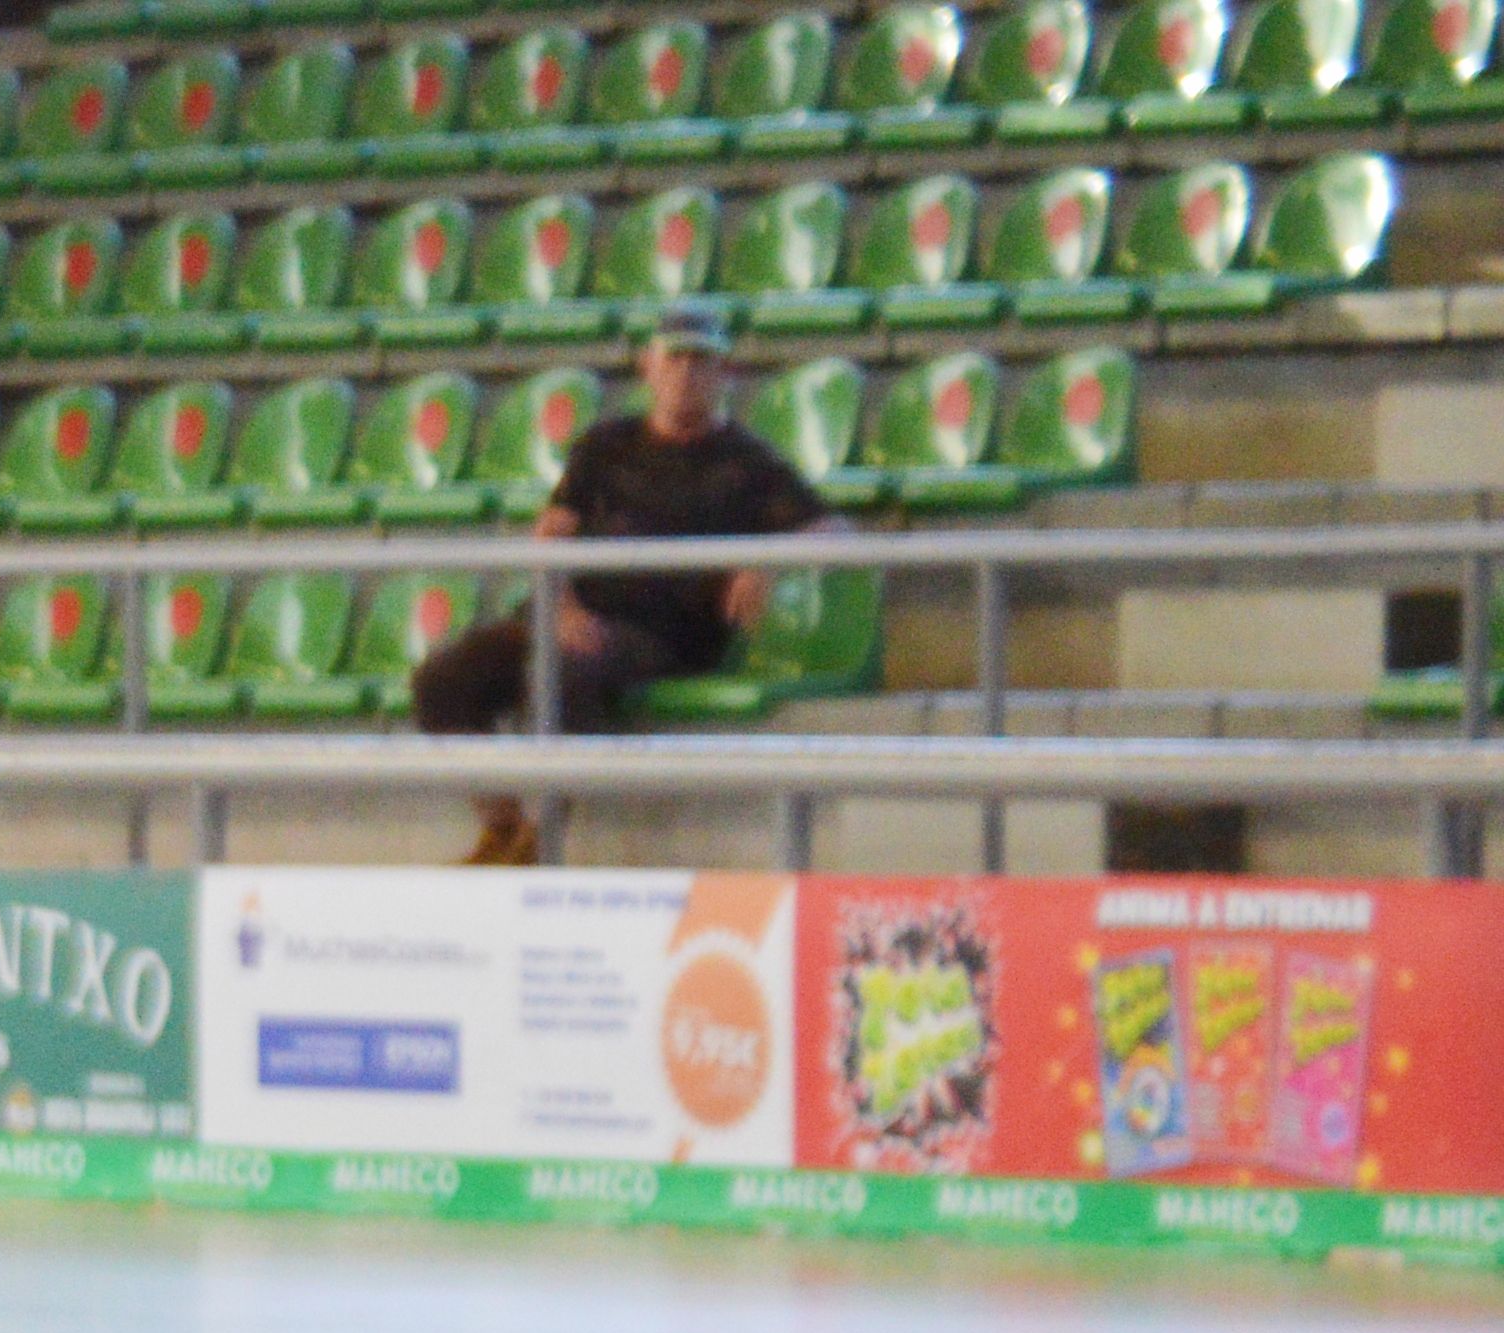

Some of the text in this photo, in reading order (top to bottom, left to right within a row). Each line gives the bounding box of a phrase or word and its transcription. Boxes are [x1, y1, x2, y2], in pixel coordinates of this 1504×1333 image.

[150, 1149, 275, 1187] MAHECO
[330, 1157, 462, 1198] MAHECO
[527, 1165, 659, 1207] MAHECO
[729, 1173, 866, 1219] MAHECO
[935, 1180, 1079, 1225] MAHECO
[1157, 1191, 1300, 1237] MAHECO
